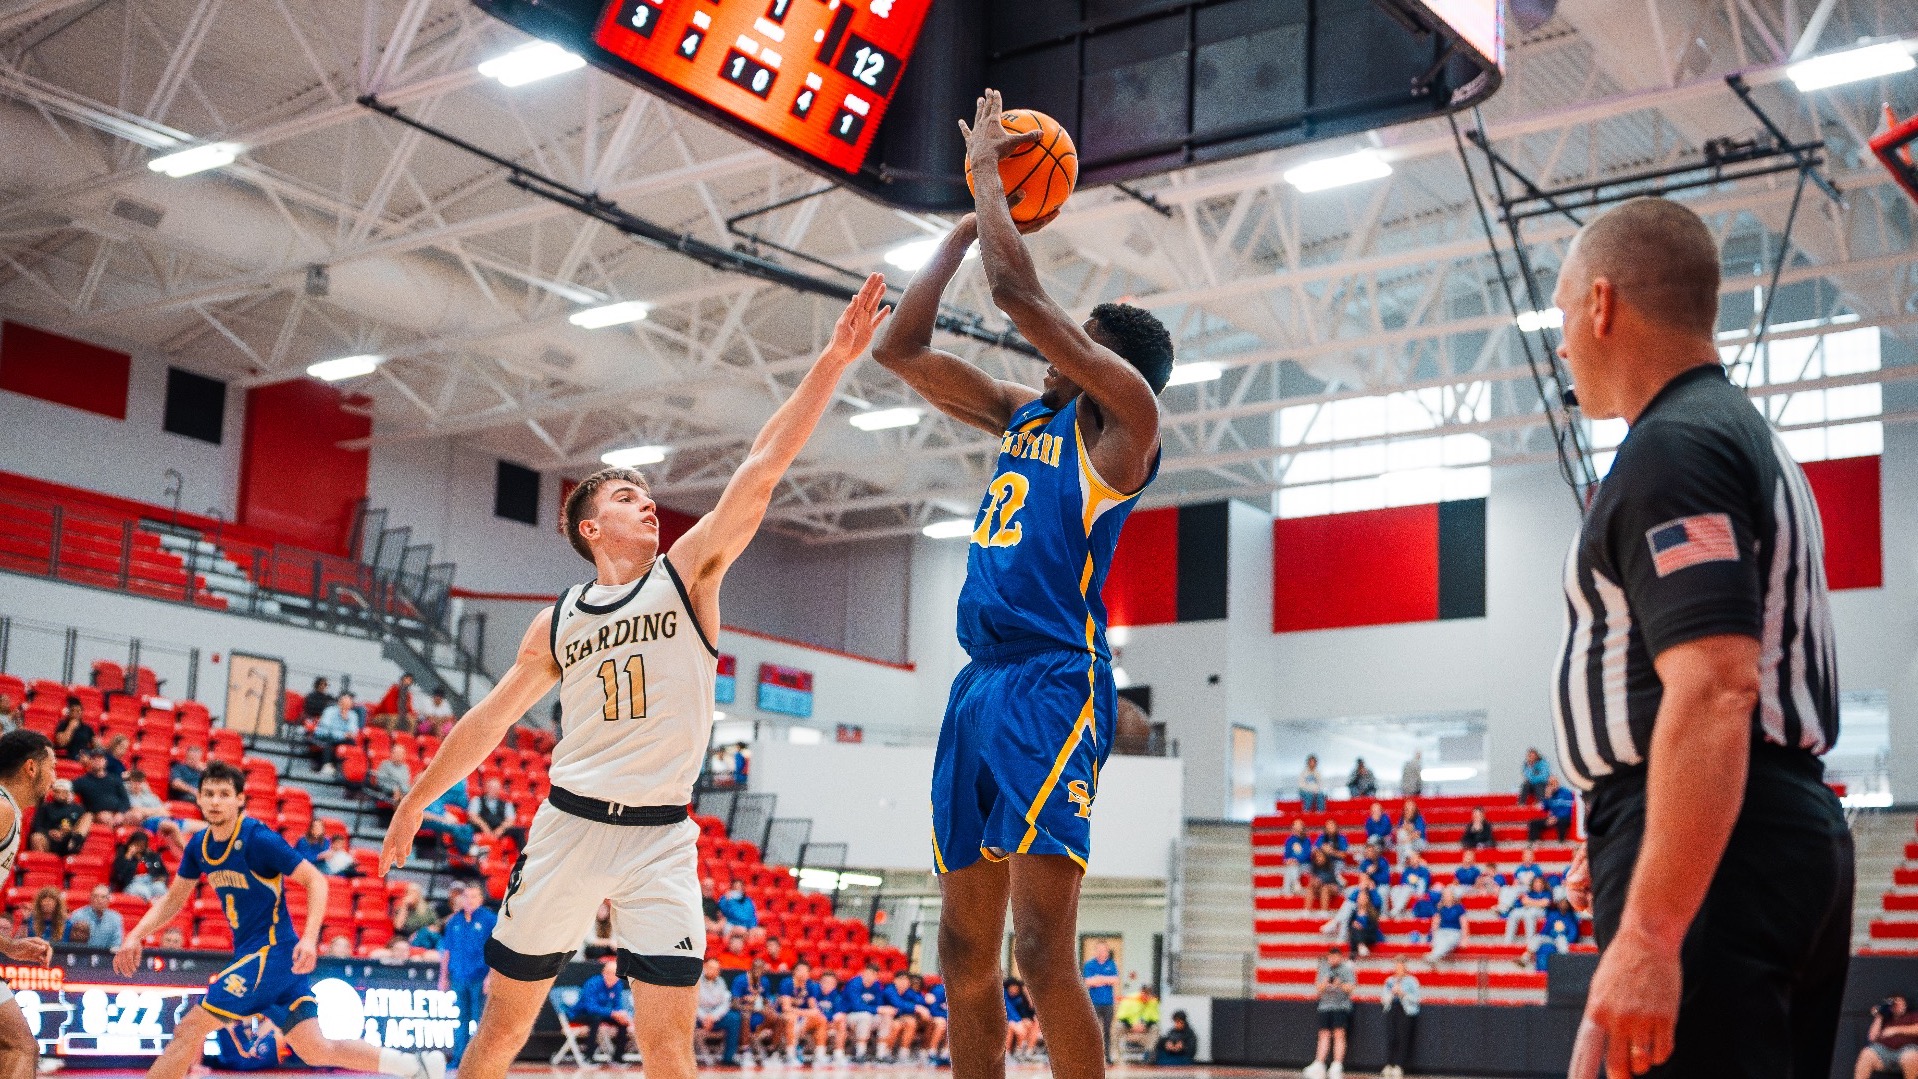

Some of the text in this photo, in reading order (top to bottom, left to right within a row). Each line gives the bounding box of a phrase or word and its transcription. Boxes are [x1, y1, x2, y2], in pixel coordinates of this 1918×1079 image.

[631, 4, 649, 28] 3
[852, 46, 885, 87] 12
[839, 113, 854, 135] 1
[564, 610, 678, 669] HARDING
[596, 653, 647, 721] 11
[81, 988, 163, 1036] 8:22
